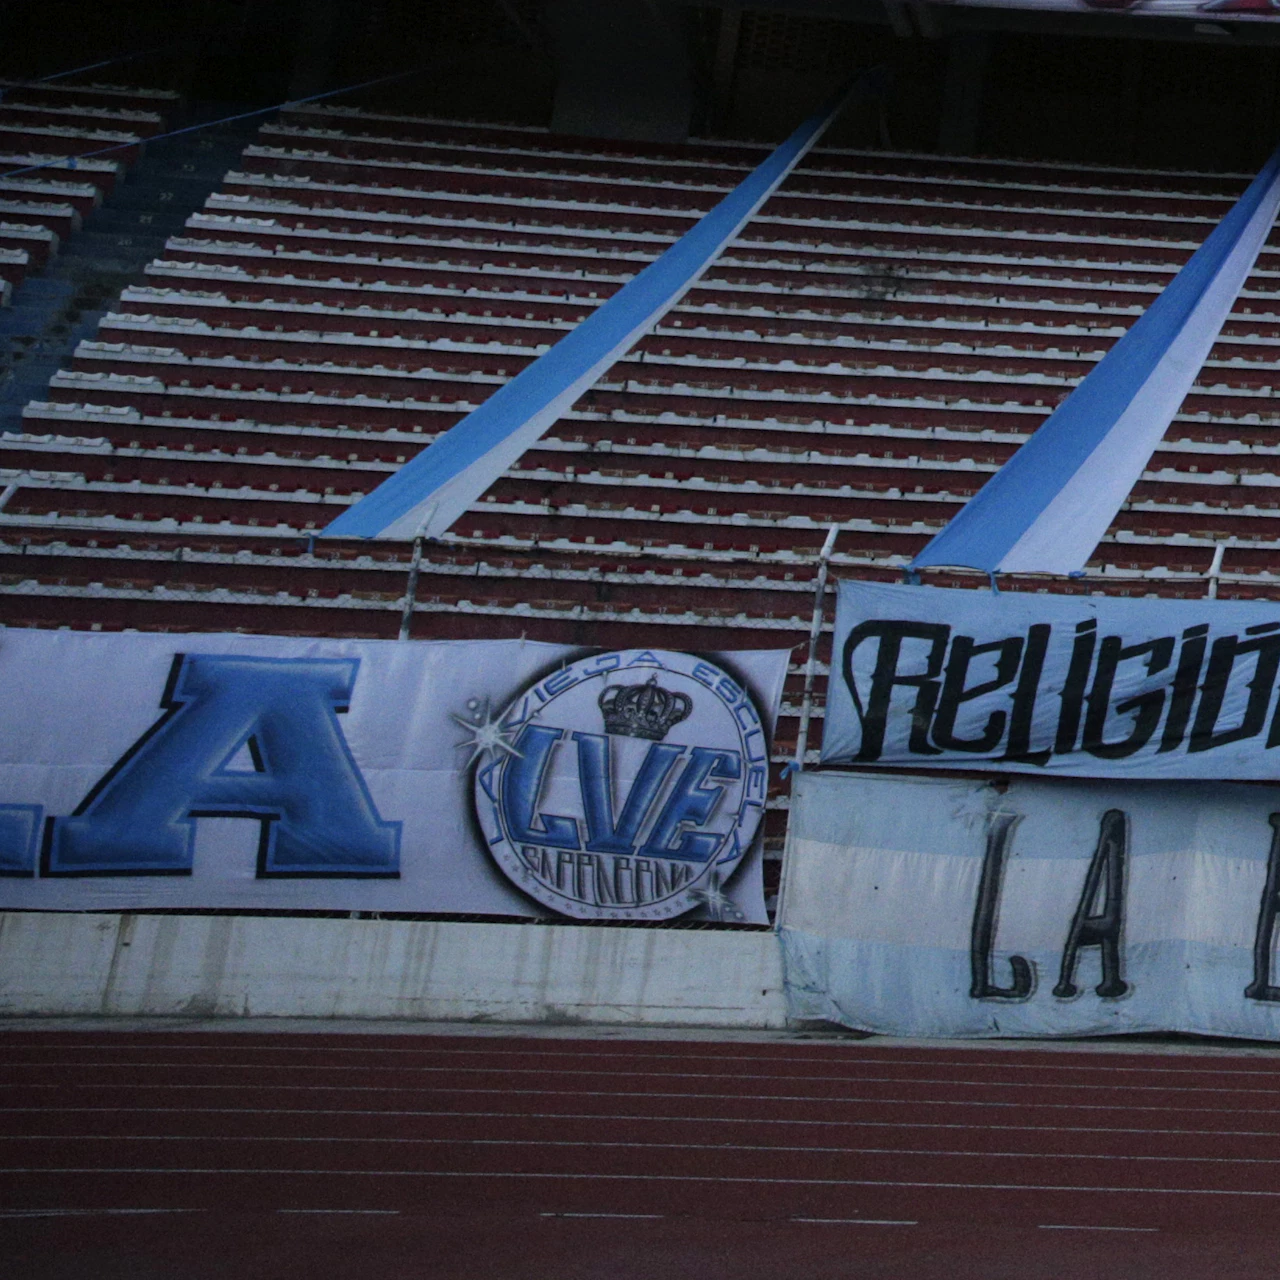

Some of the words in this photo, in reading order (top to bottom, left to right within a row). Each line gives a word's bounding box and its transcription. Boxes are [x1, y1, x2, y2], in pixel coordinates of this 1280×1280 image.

[501, 723, 743, 864] LVE
[504, 650, 666, 729] VIEJA
[690, 661, 767, 867] ESCUELA
[968, 808, 1131, 999] LA
